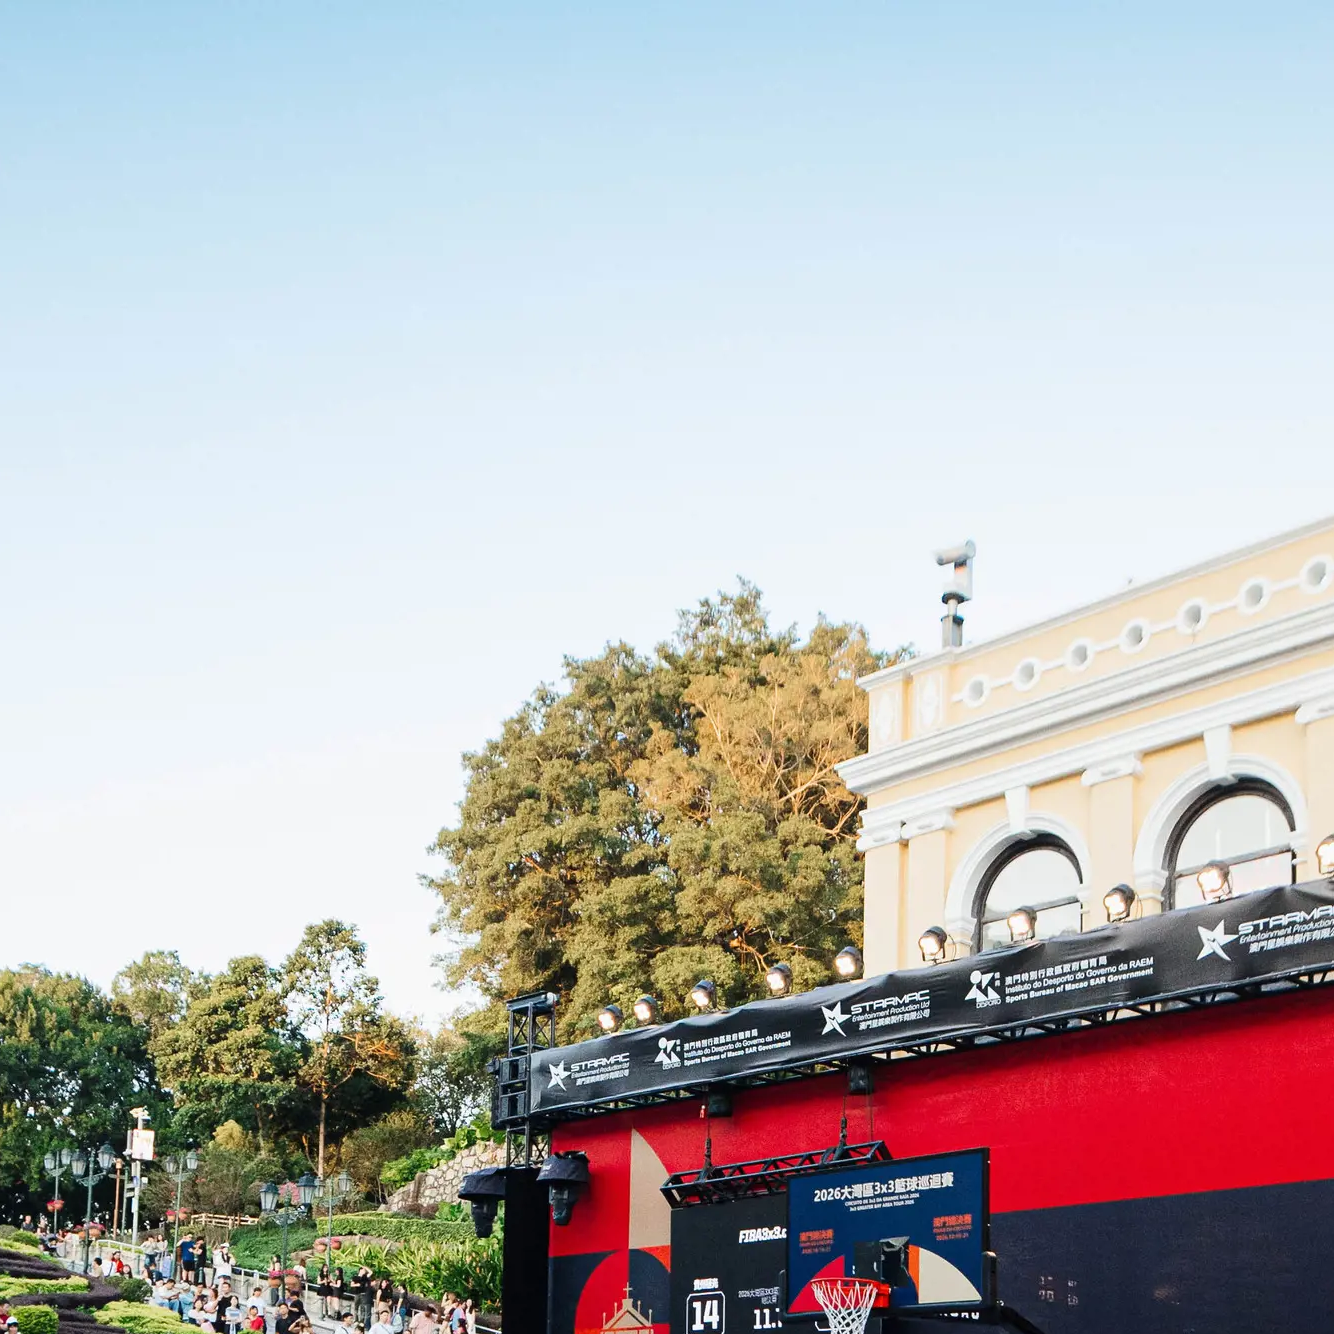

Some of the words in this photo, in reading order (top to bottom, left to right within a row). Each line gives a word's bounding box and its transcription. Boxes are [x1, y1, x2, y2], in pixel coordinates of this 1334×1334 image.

[850, 989, 930, 1014] STARMAC
[570, 1052, 630, 1071] STARMAC
[692, 1300, 720, 1331] 14
